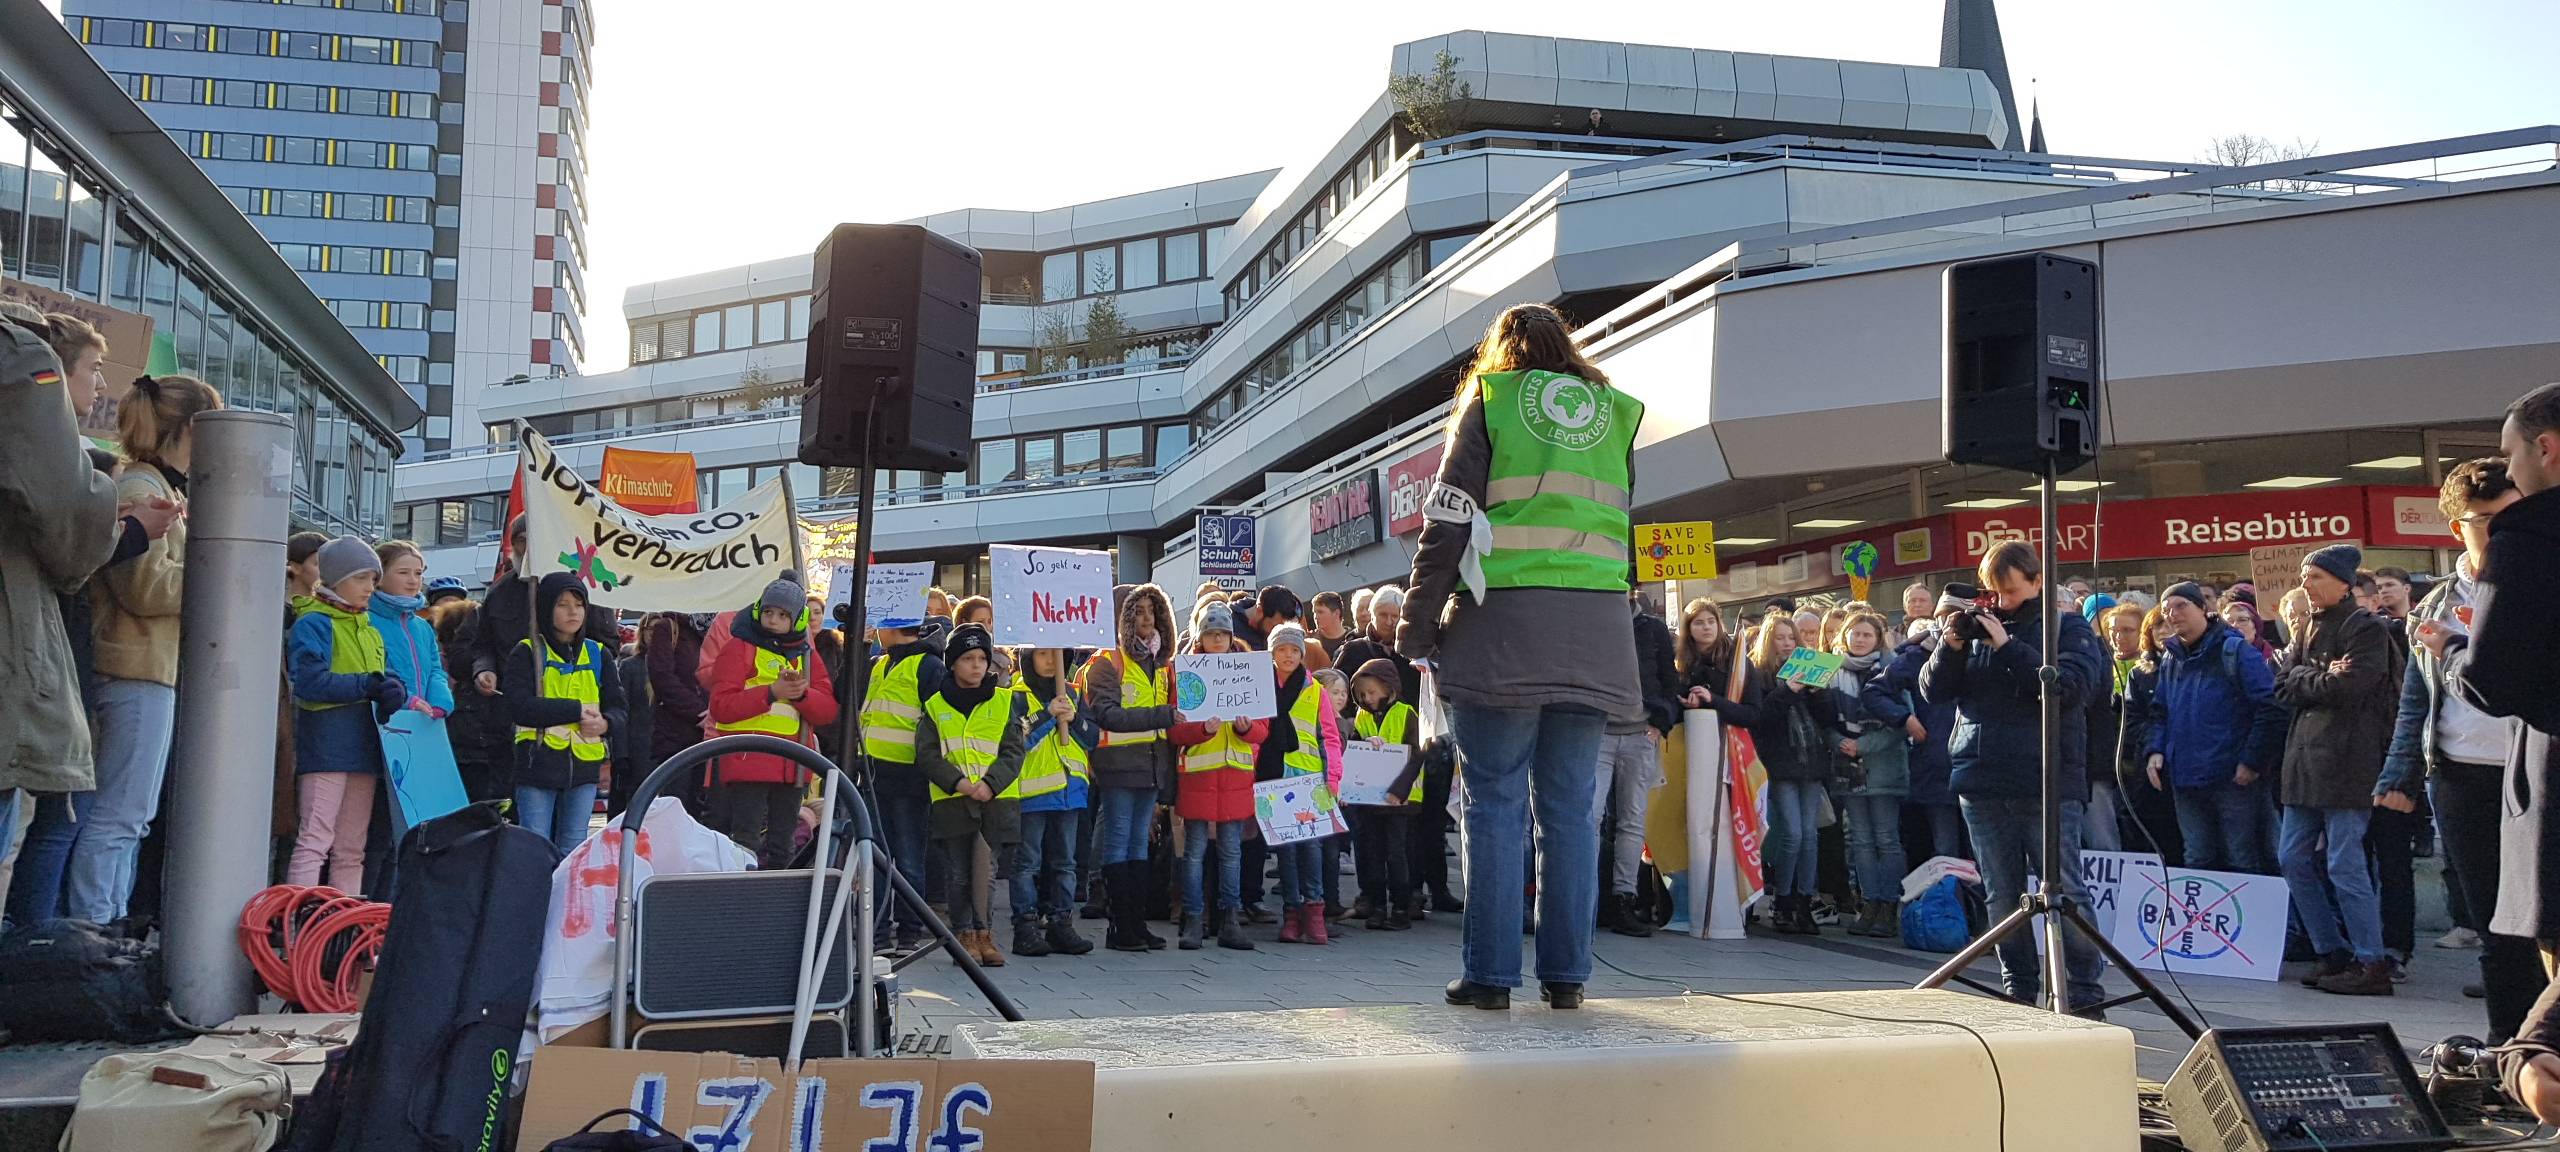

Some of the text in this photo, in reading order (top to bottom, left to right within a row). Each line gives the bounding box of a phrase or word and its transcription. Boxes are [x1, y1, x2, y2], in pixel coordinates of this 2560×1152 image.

[1525, 377, 1543, 424] ADULTS
[1547, 402, 1608, 444] LEVERKUSEN
[605, 472, 673, 497] Klimaschutz
[636, 518, 691, 541] den
[1652, 528, 1694, 541] SAVE
[2165, 511, 2352, 545] Reisebüro
[594, 521, 780, 574] verbrauch
[1024, 550, 1044, 575] So
[1200, 561, 1254, 569] Schlüsseldienst
[1653, 563, 1698, 578] SOUL
[1032, 590, 1098, 624] Nicht!
[1182, 655, 1250, 671] Wir haben
[1791, 648, 1816, 661] NO
[1212, 674, 1254, 686] nur eine
[2143, 903, 2229, 935] BAYER
